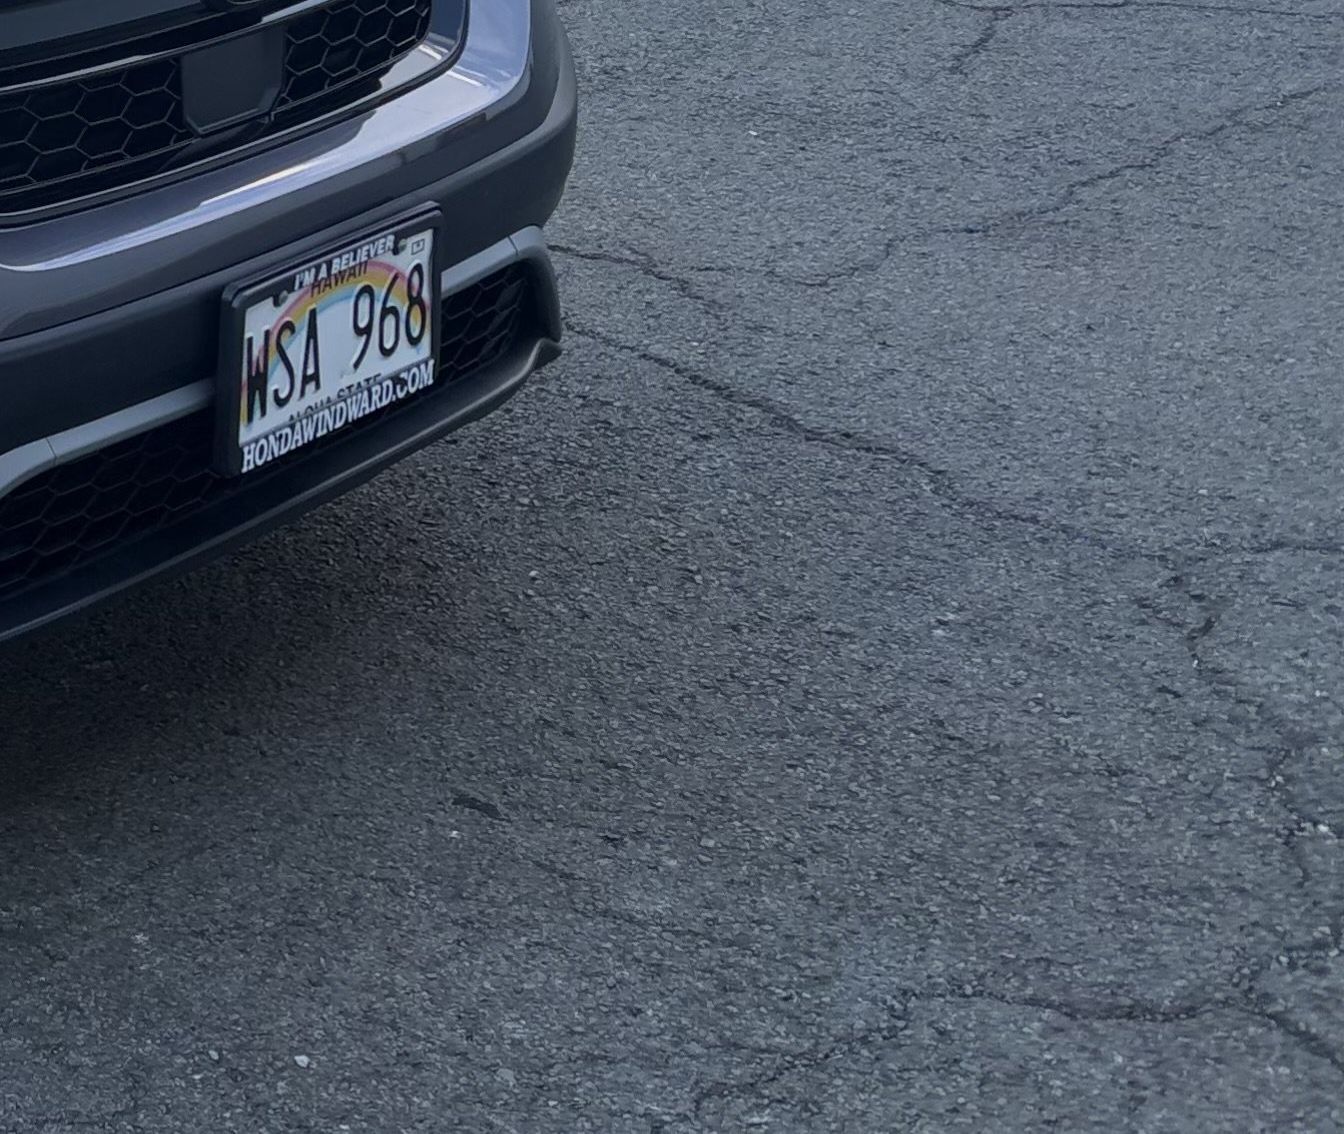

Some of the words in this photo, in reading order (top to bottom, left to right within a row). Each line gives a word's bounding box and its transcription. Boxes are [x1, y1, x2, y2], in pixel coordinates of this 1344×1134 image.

[294, 266, 317, 292] I'M
[317, 262, 329, 282] A
[331, 233, 396, 276] BELIEVER
[246, 306, 322, 426] WSA
[351, 262, 428, 372] 968
[241, 359, 436, 475] HONDAWINDWARD.COM
